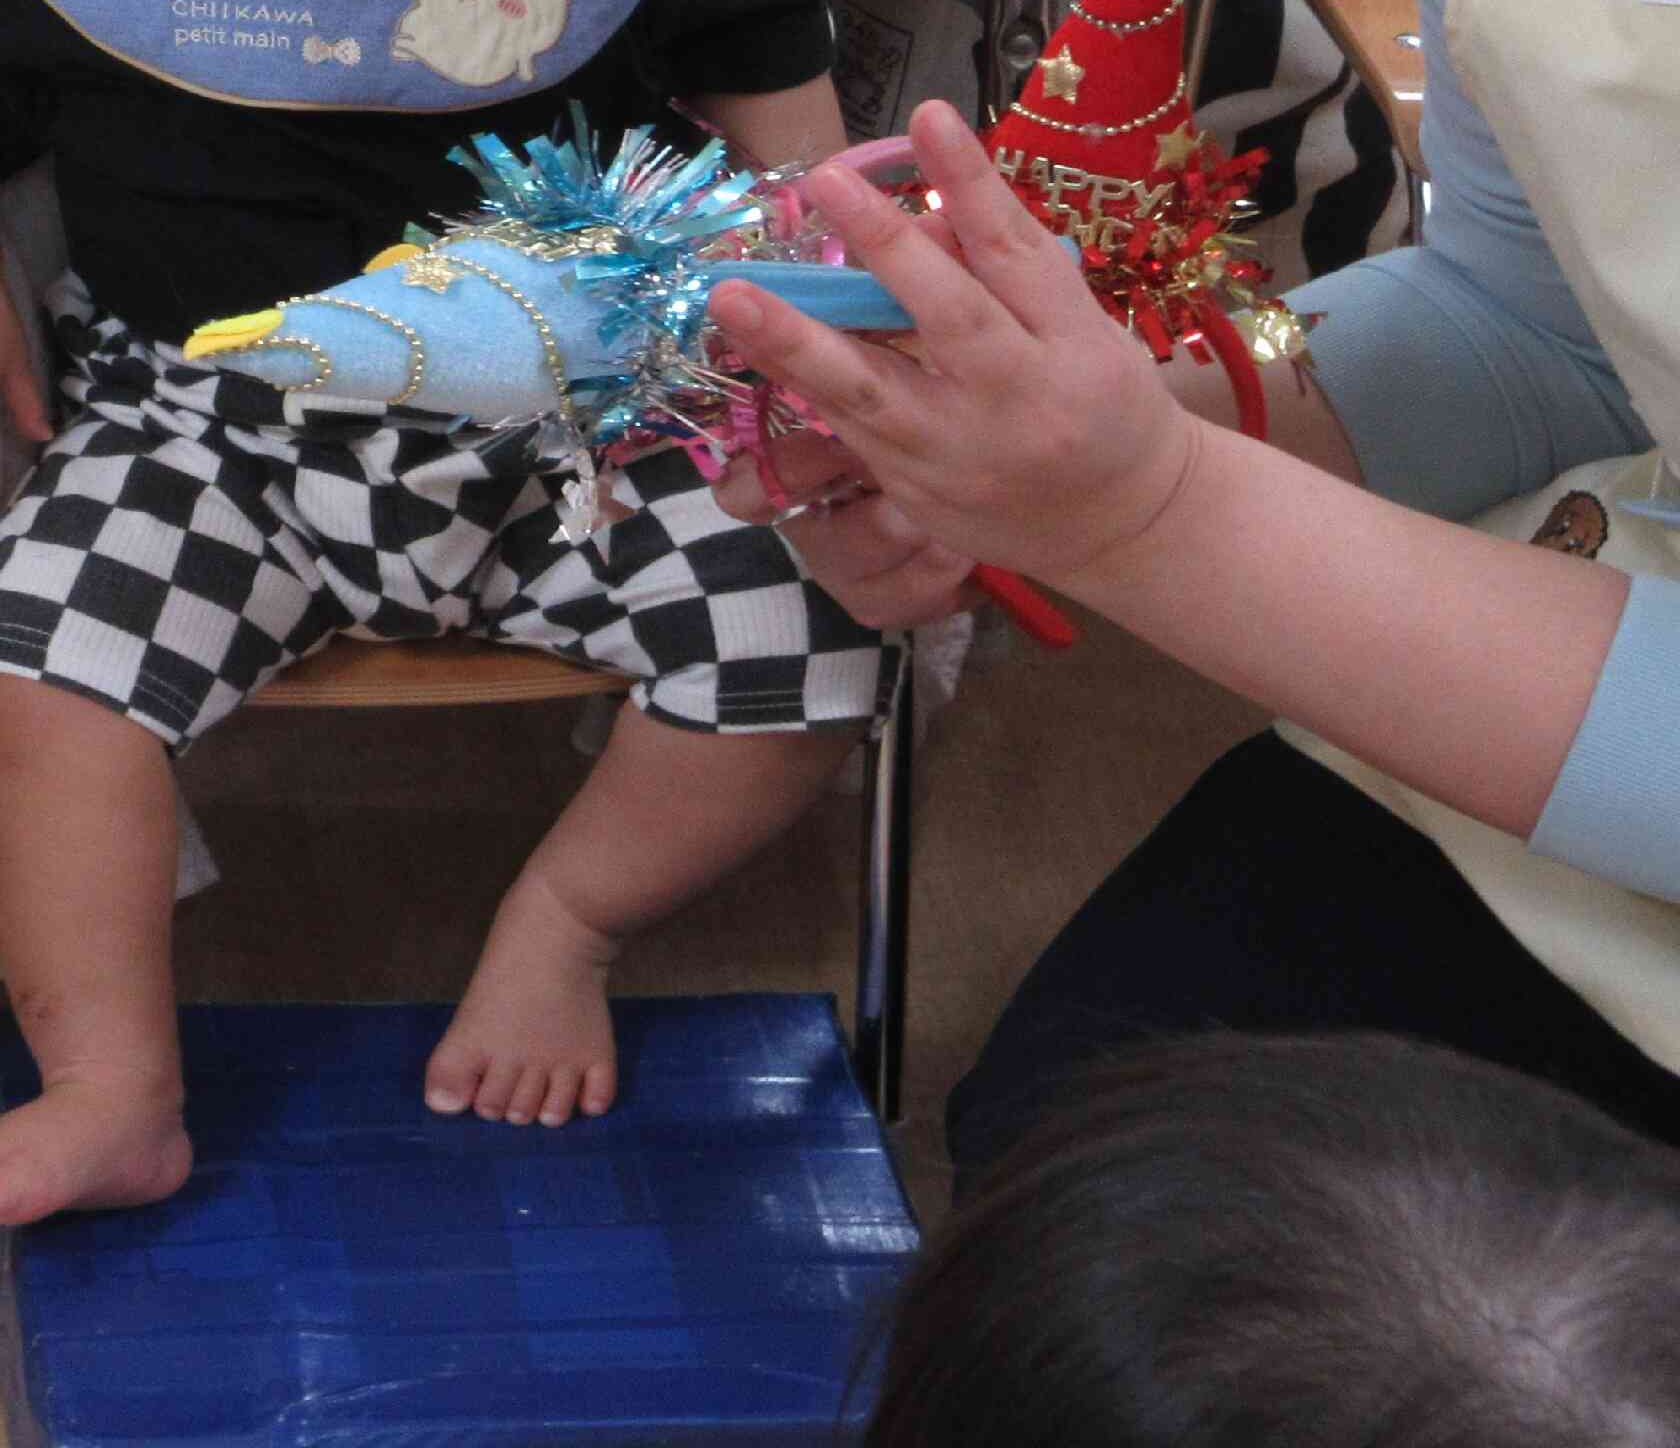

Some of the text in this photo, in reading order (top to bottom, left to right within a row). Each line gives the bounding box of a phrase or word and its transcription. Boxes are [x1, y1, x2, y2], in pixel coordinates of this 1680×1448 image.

[171, 0, 315, 27] CHIIKAWA
[174, 26, 290, 50] petit main
[992, 146, 1176, 219] HAPPY
